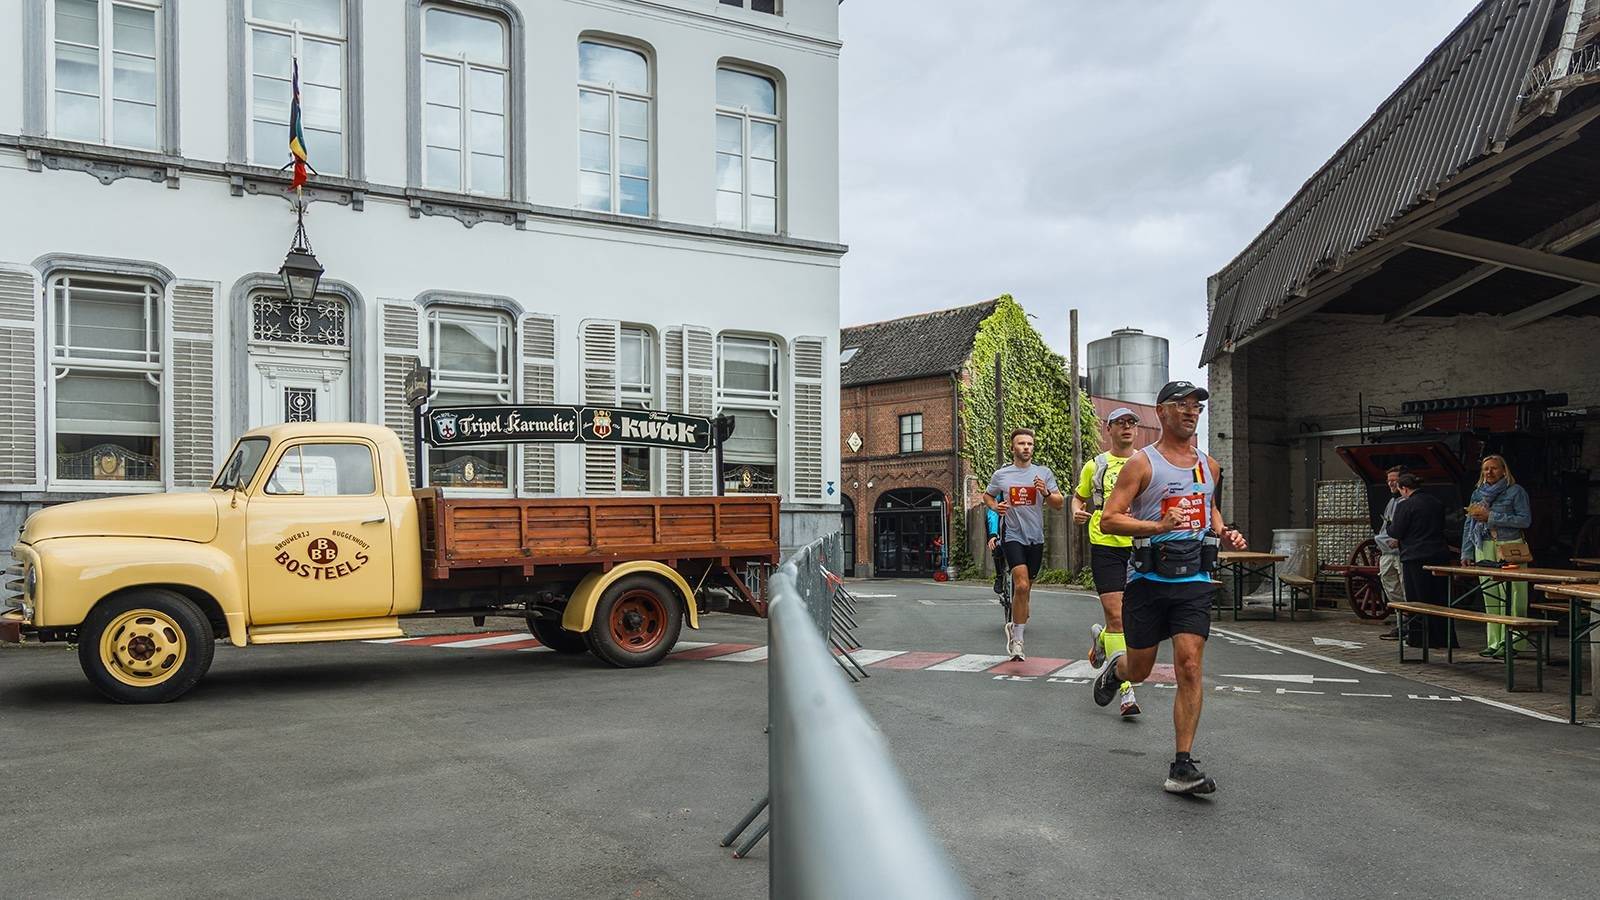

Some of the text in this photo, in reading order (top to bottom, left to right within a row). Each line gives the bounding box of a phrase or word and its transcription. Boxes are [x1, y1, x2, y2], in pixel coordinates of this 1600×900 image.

[458, 410, 575, 438] Tripel Karmeliet
[274, 530, 310, 551] BROUWERIJ
[332, 529, 370, 550] BUGGENHOUT
[274, 551, 369, 580] BOSTEELS
